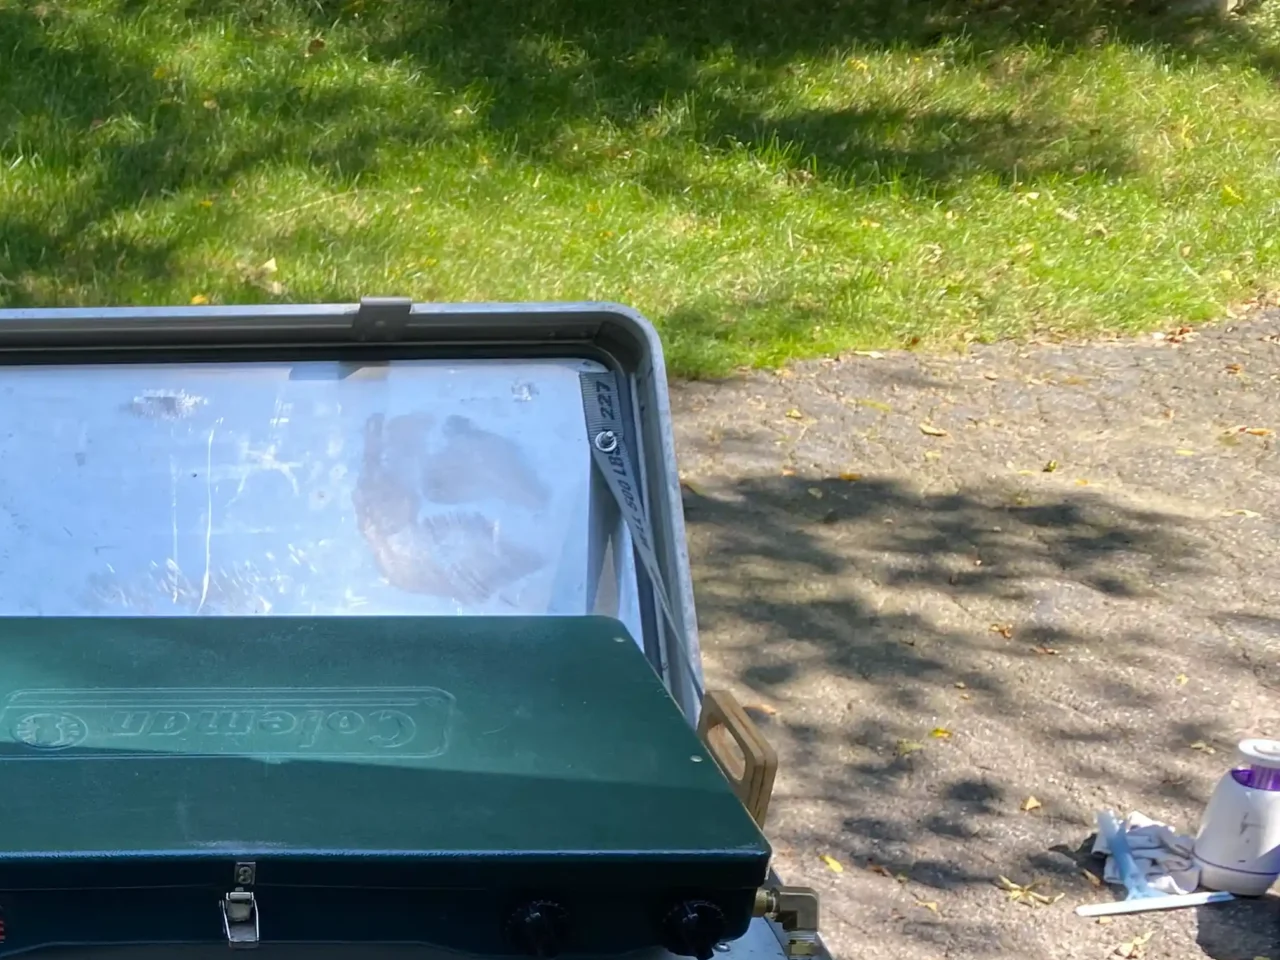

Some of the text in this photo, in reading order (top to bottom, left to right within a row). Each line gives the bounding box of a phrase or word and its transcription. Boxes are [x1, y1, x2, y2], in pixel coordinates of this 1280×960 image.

[596, 381, 615, 420] 227
[617, 479, 638, 512] 500
[111, 708, 417, 748] Coleman
